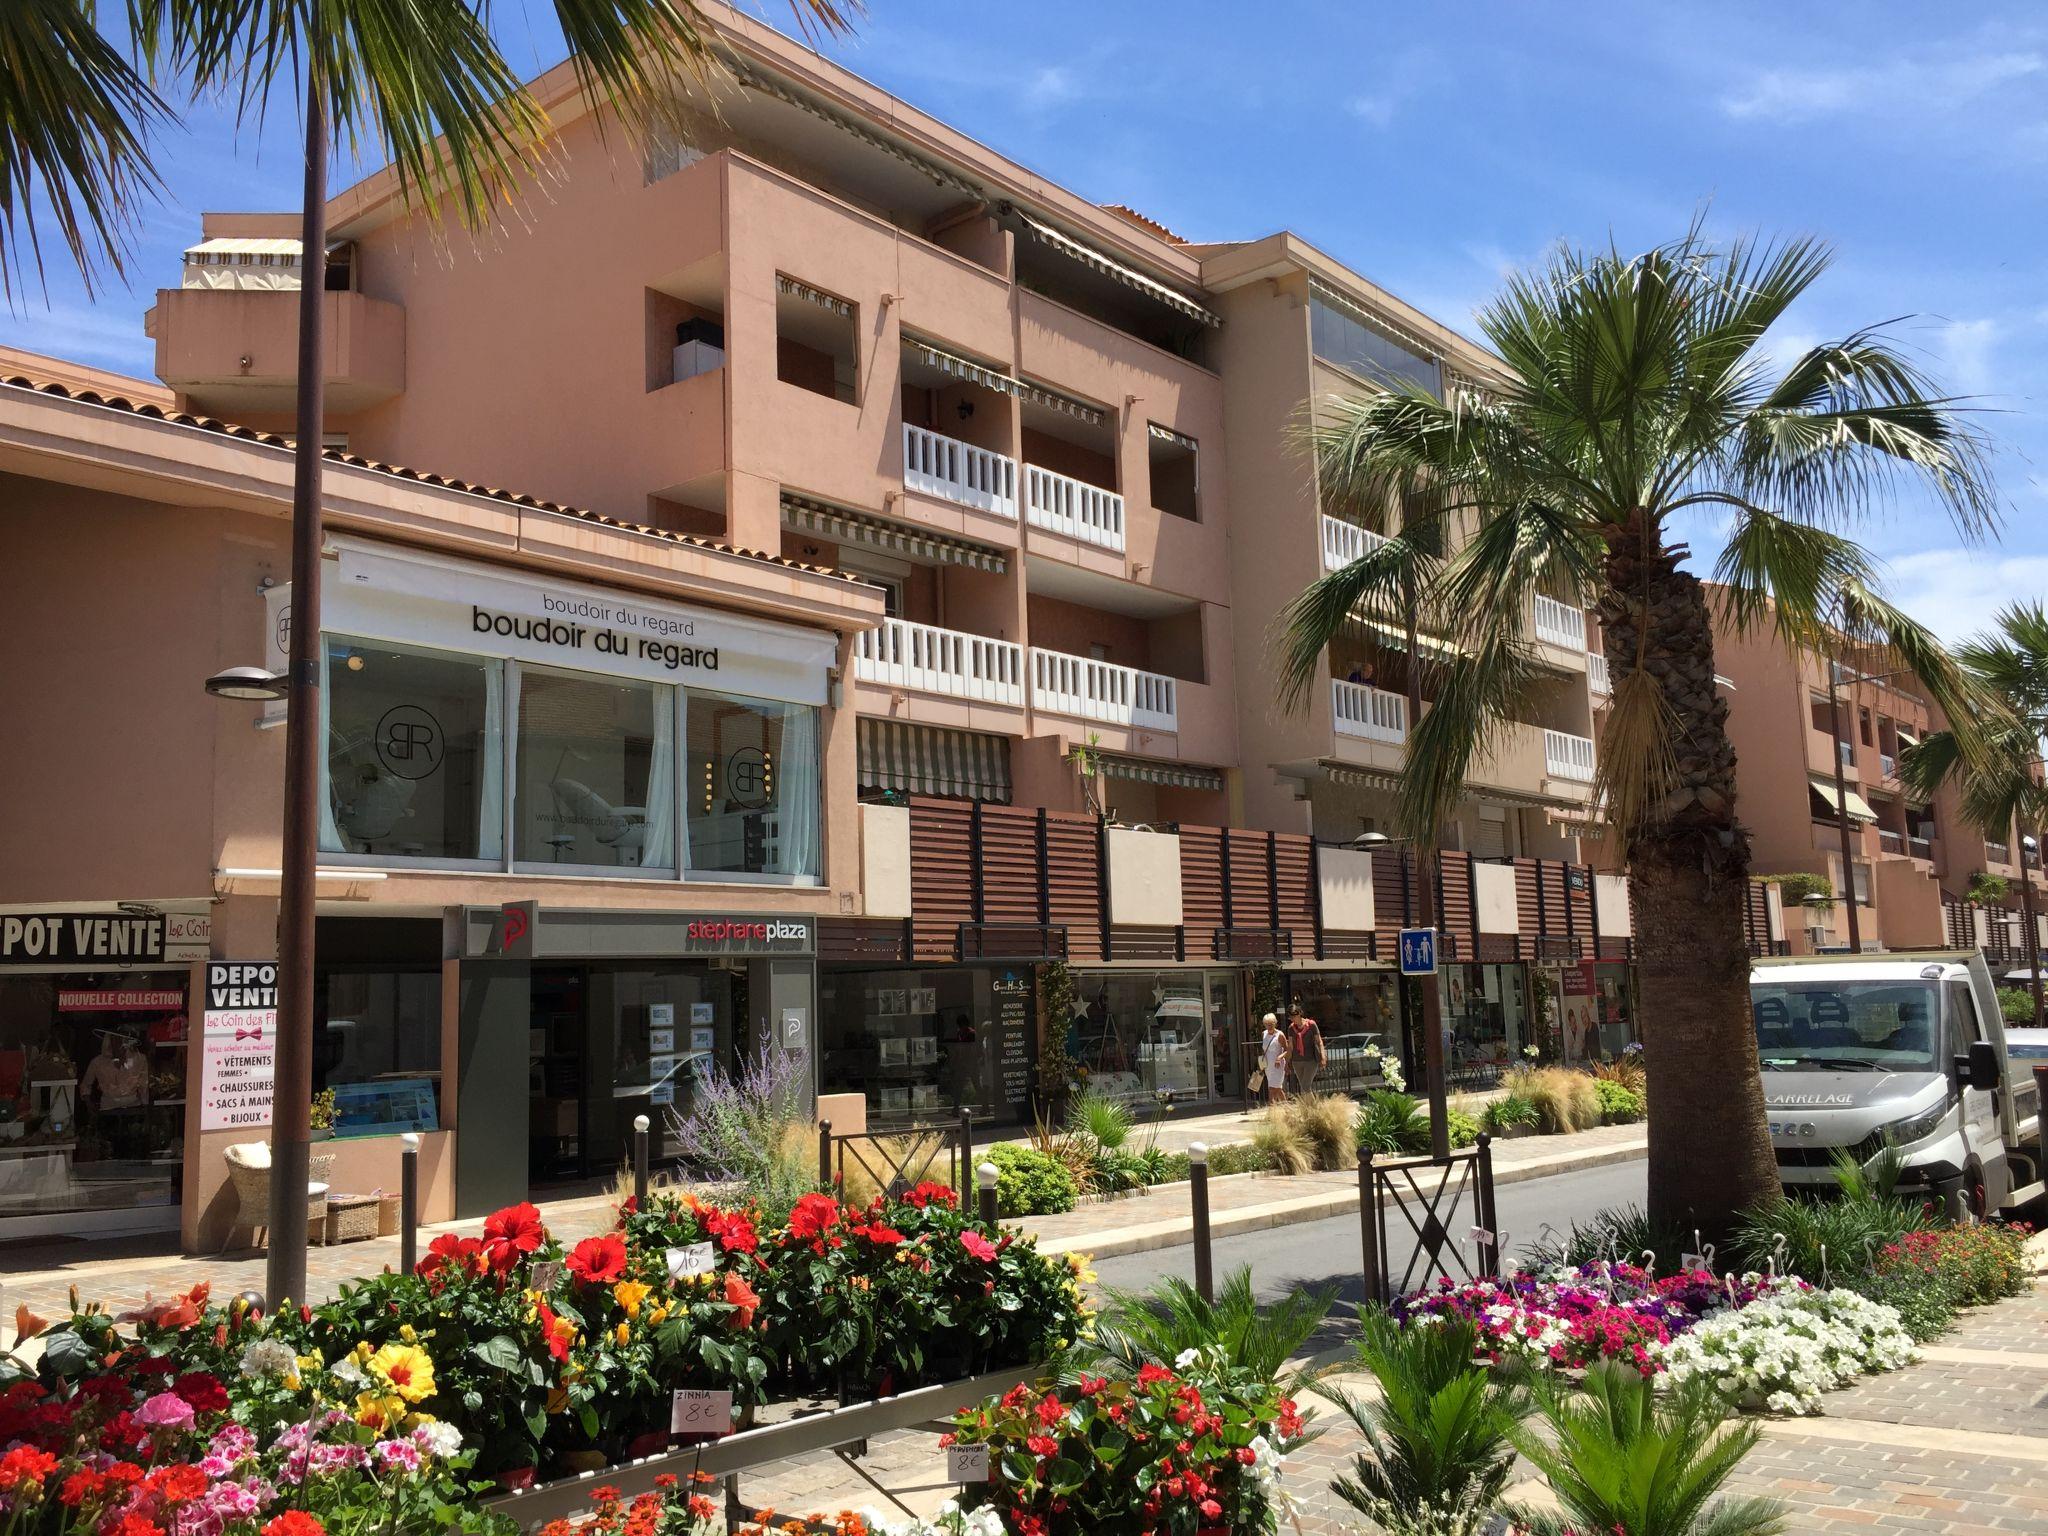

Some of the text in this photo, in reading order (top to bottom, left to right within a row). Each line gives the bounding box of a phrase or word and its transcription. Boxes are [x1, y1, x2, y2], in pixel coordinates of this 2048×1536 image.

[543, 594, 695, 637] boudoir du regard
[472, 605, 719, 671] boudoir du regard
[168, 919, 184, 938] Le
[0, 917, 162, 956] POT VENTE
[211, 965, 279, 985] DEPO
[58, 992, 183, 1007] NOUVELLE COLLECTION
[221, 1012, 243, 1028] Coin
[245, 1012, 263, 1026] des
[224, 1055, 272, 1067] VÊTEMENTS
[217, 1069, 243, 1078] FEMMES
[220, 1080, 274, 1094] CHAUSSURES
[216, 1098, 237, 1110] SACS
[1765, 1093, 1853, 1104] CARRELAGE
[230, 1111, 262, 1123] BIJOUX
[1769, 1122, 1816, 1137] ECO
[676, 1391, 711, 1400] ZINNIA
